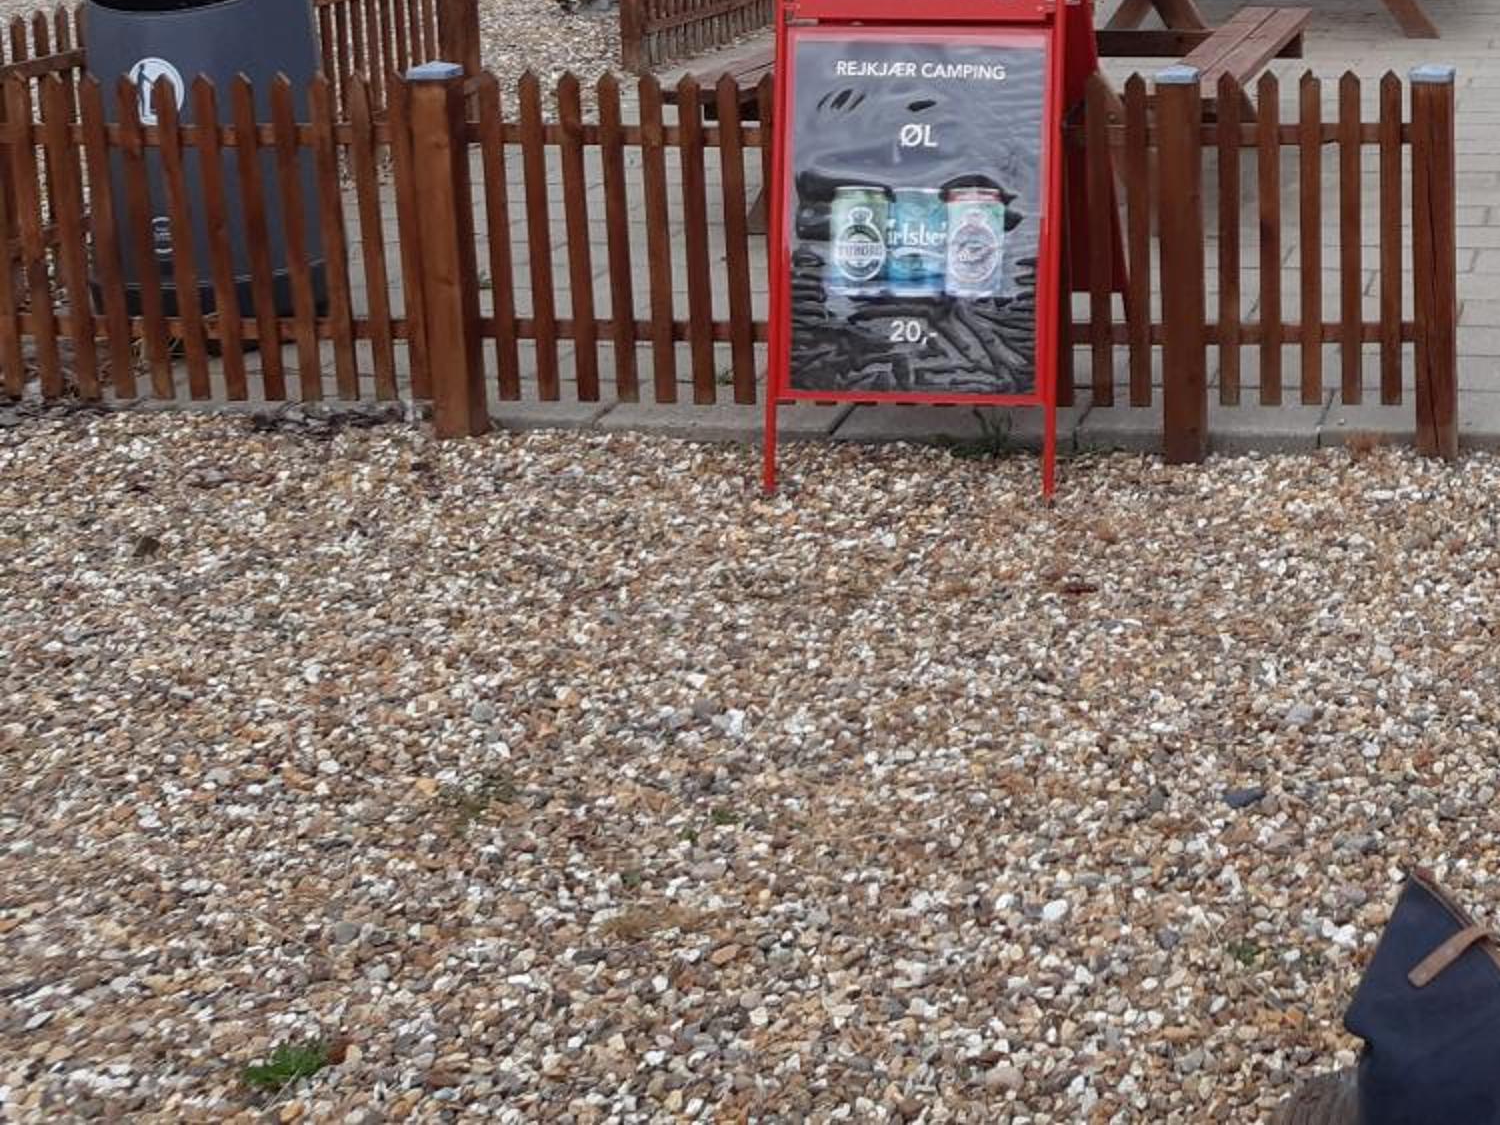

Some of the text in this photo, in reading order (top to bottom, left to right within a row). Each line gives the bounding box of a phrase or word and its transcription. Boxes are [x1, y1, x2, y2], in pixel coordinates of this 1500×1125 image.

[836, 61, 1006, 80] REJKJÆR CAMPING
[900, 125, 938, 148] ØL
[890, 321, 938, 344] 20,-
